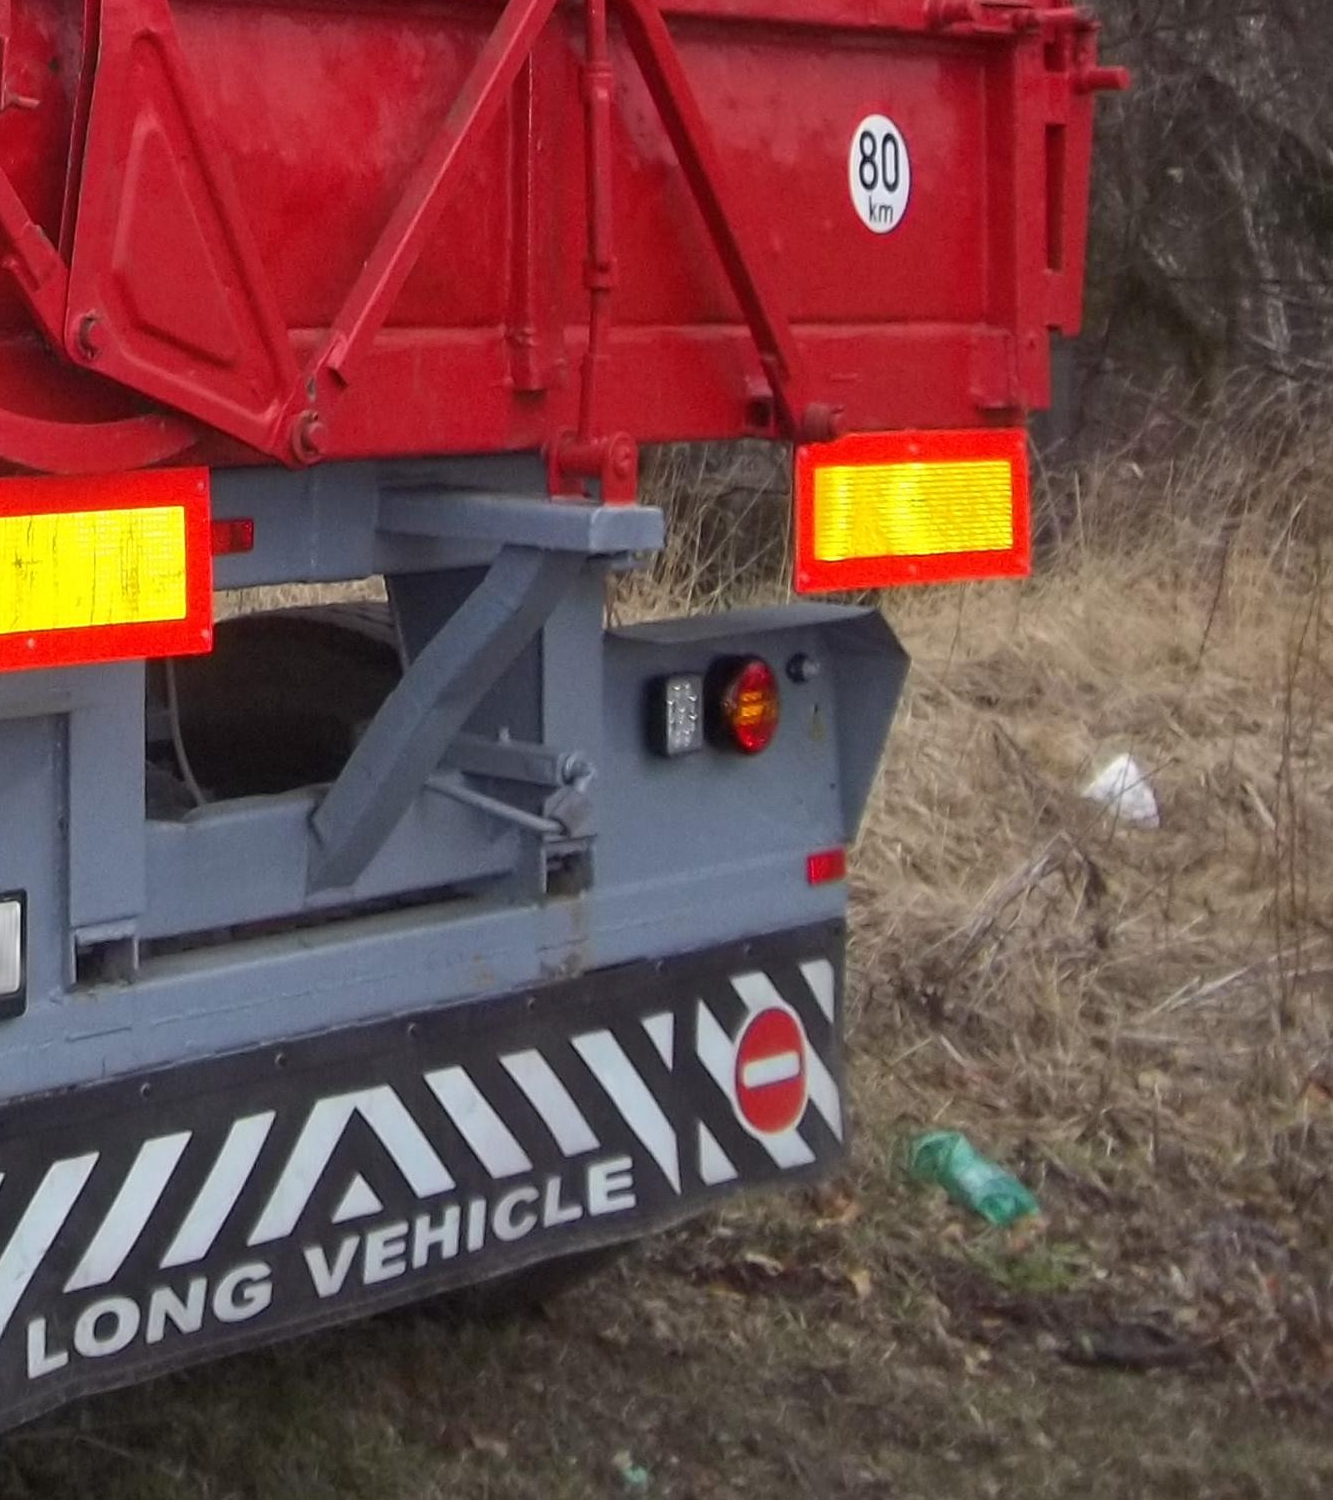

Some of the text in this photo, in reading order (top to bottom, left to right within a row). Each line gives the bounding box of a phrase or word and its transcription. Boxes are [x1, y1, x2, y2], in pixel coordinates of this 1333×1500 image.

[859, 130, 900, 193] 80
[868, 195, 894, 223] km
[25, 1155, 637, 1380] LONG VEHICLE
